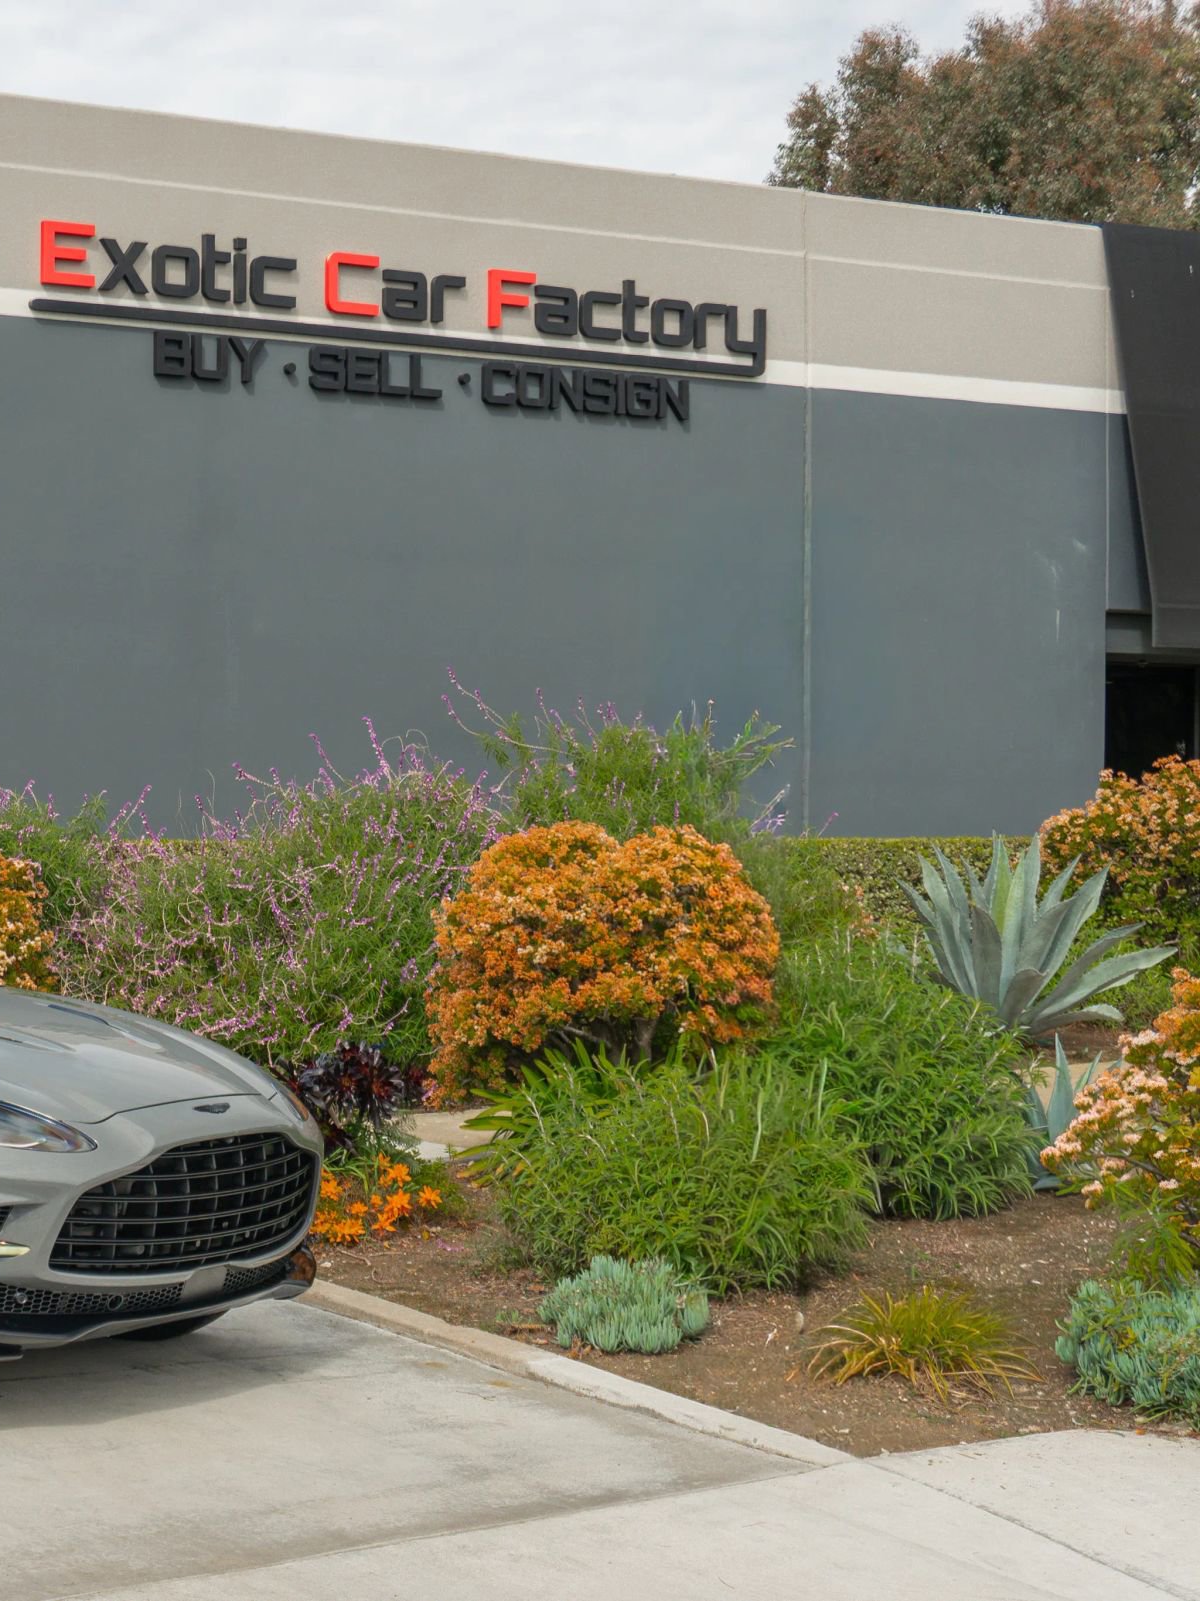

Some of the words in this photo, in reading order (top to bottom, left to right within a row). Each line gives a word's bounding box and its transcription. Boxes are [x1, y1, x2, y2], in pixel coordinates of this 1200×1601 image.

[40, 219, 297, 309] Exotic
[325, 251, 467, 323] Car
[487, 268, 768, 377] Factory
[153, 330, 266, 383] BUY
[308, 345, 443, 400] SELL
[481, 361, 690, 421] CONSIGN
